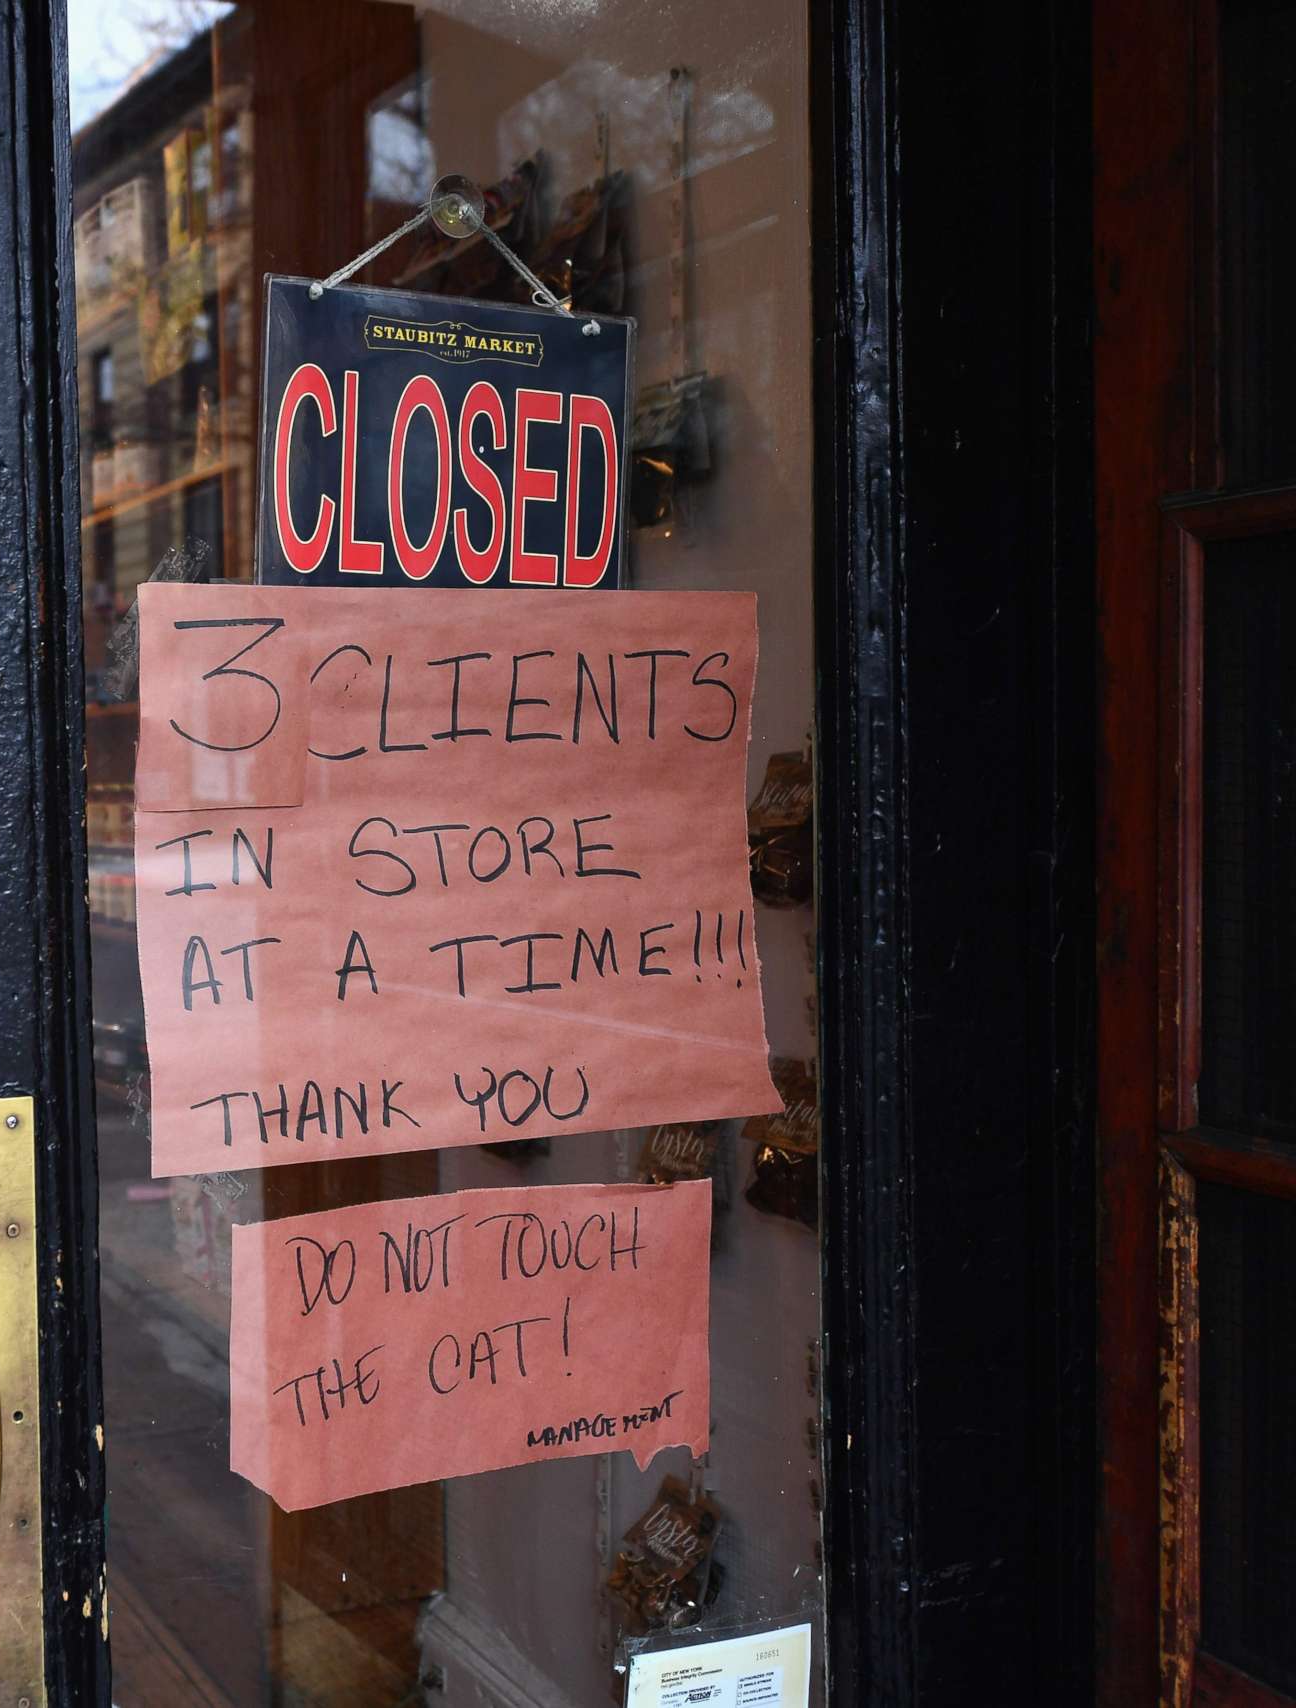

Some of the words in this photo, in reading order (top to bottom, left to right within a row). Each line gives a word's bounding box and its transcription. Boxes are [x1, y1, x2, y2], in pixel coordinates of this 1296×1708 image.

[373, 325, 457, 346] STAUBITZ
[464, 335, 535, 355] MARKET
[274, 362, 619, 588] CLOSED
[170, 617, 284, 752] 3
[307, 644, 738, 760] CLIENTS
[155, 826, 273, 897] IN
[349, 814, 642, 897] STORE
[182, 935, 281, 1011] AT
[336, 930, 379, 1001] A
[429, 909, 747, 998] TIME!!!
[190, 1079, 421, 1147] THANK
[454, 1065, 590, 1132] YOU
[285, 1236, 357, 1316] DO
[379, 1214, 467, 1293] NOT
[475, 1206, 647, 1280] TOUCH
[273, 1344, 386, 1425] THE
[429, 1297, 572, 1393] CAT!
